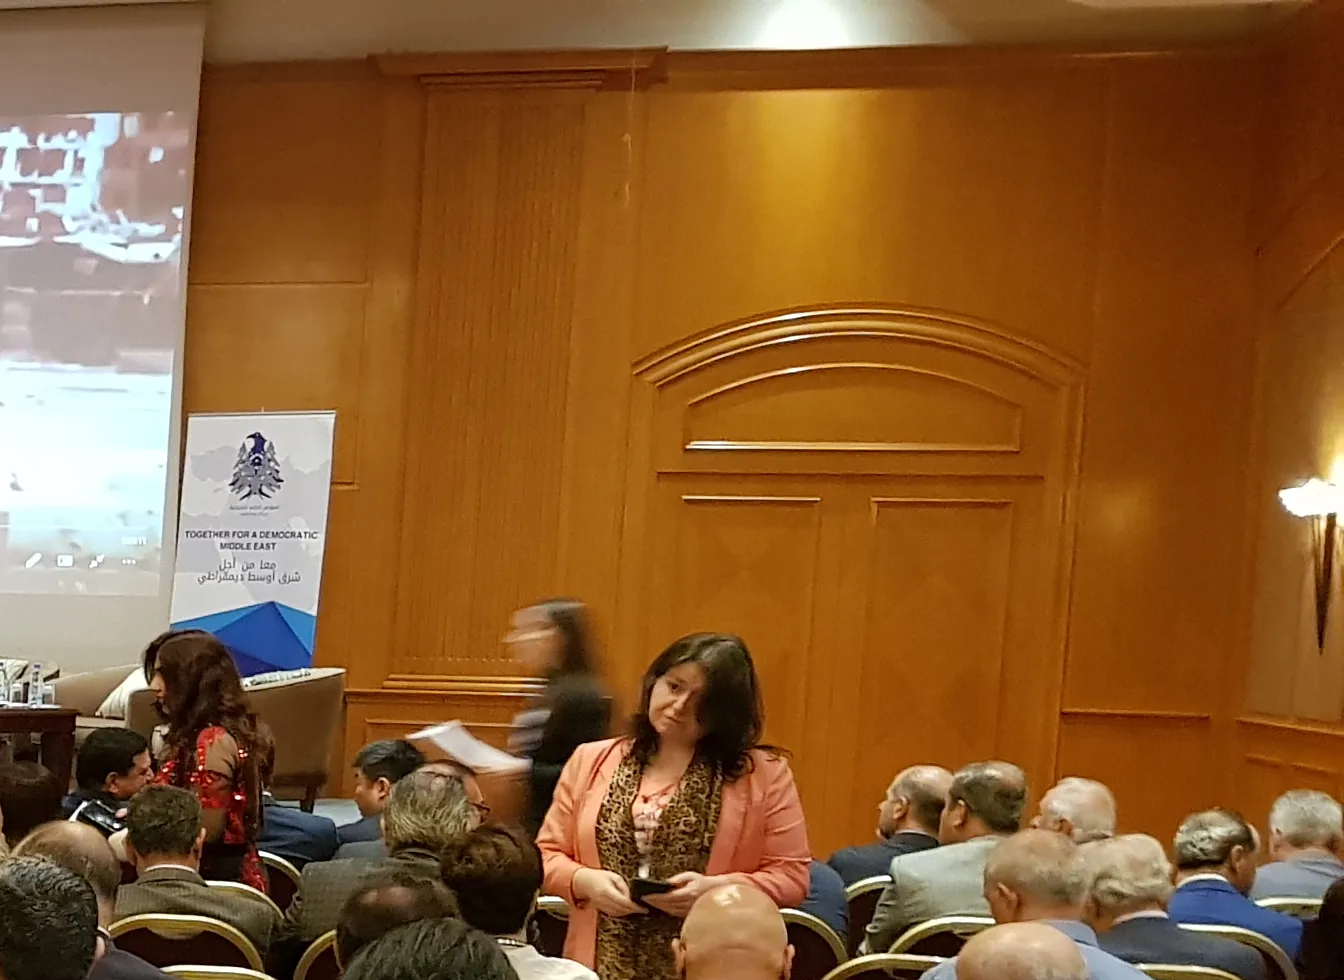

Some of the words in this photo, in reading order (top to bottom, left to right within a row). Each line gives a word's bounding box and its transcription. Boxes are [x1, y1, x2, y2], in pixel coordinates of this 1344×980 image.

[185, 530, 230, 539] TOGETHER
[232, 530, 250, 539] FOR
[251, 530, 258, 539] A
[259, 530, 320, 540] DEMOCRATIC
[219, 542, 252, 551] MIDDLE
[253, 542, 277, 551] EAST
[218, 556, 236, 571] أجل
[241, 561, 255, 572] من
[260, 559, 277, 570] معا
[197, 570, 244, 585] ديمقراطي
[278, 571, 301, 585] شرق
